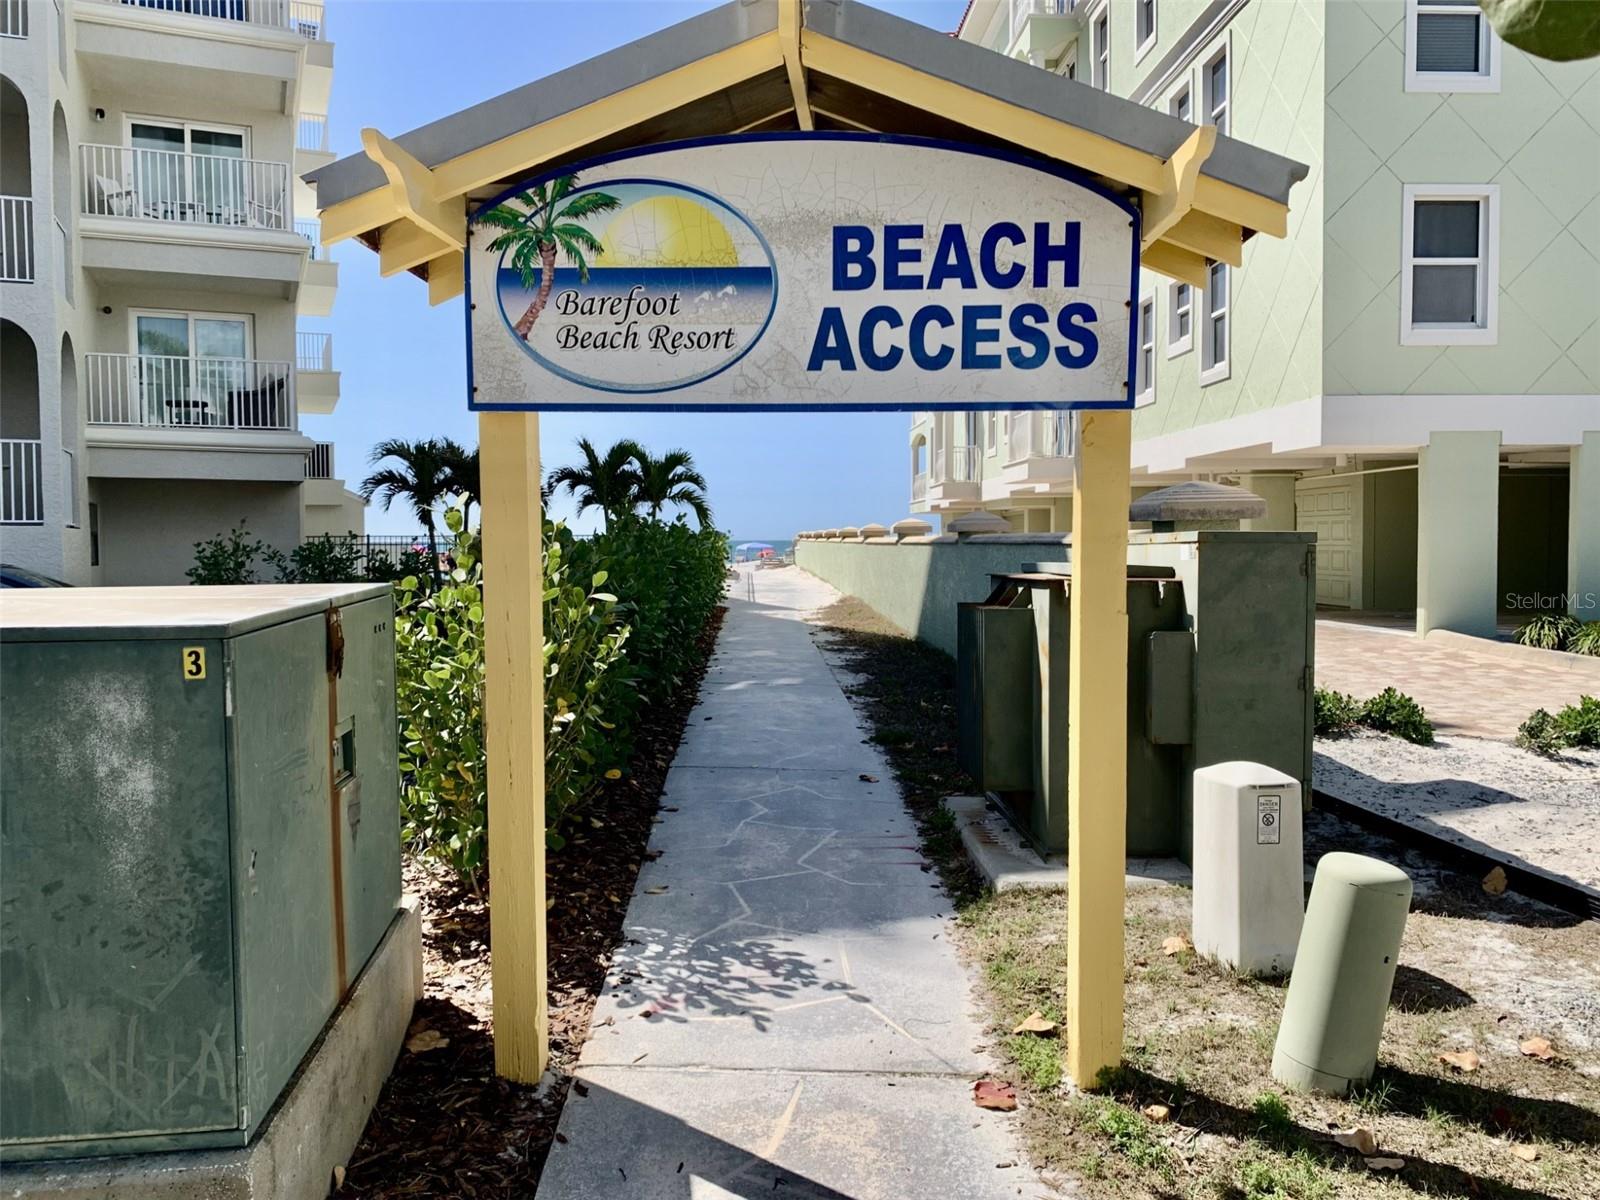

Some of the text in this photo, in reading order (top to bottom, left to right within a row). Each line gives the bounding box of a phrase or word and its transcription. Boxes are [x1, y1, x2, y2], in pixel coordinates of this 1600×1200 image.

[832, 221, 1081, 291] BEACH
[556, 286, 681, 325] Barefoot
[556, 321, 735, 355] Beach Resort
[806, 302, 1099, 371] ACCESS
[187, 650, 202, 676] 3
